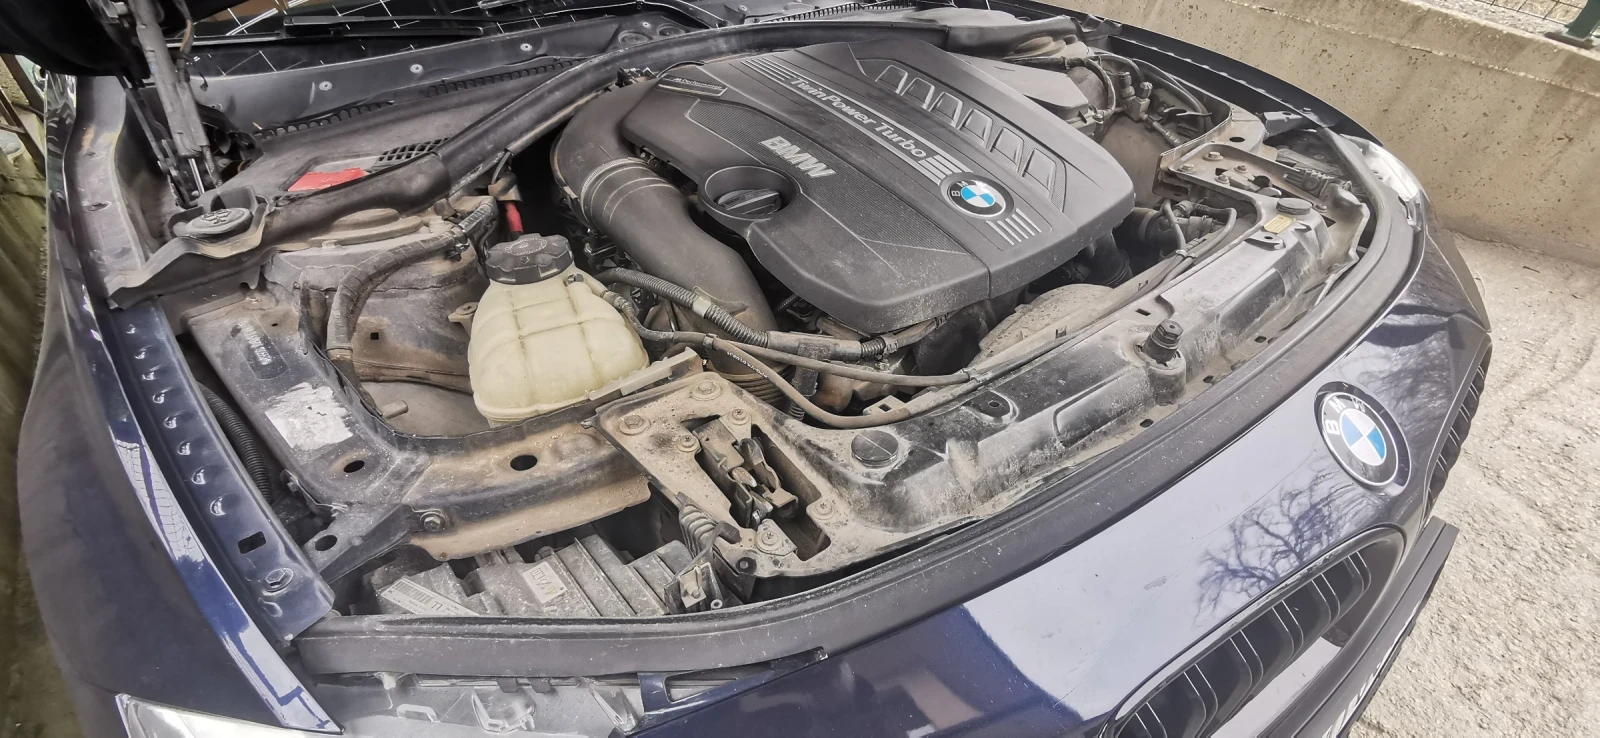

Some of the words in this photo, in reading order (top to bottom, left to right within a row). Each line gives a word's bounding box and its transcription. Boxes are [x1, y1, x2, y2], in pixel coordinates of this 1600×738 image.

[790, 77, 877, 124] TwinPower
[874, 122, 927, 158] Turbo
[759, 135, 837, 178] BMW
[1325, 396, 1366, 435] BMW
